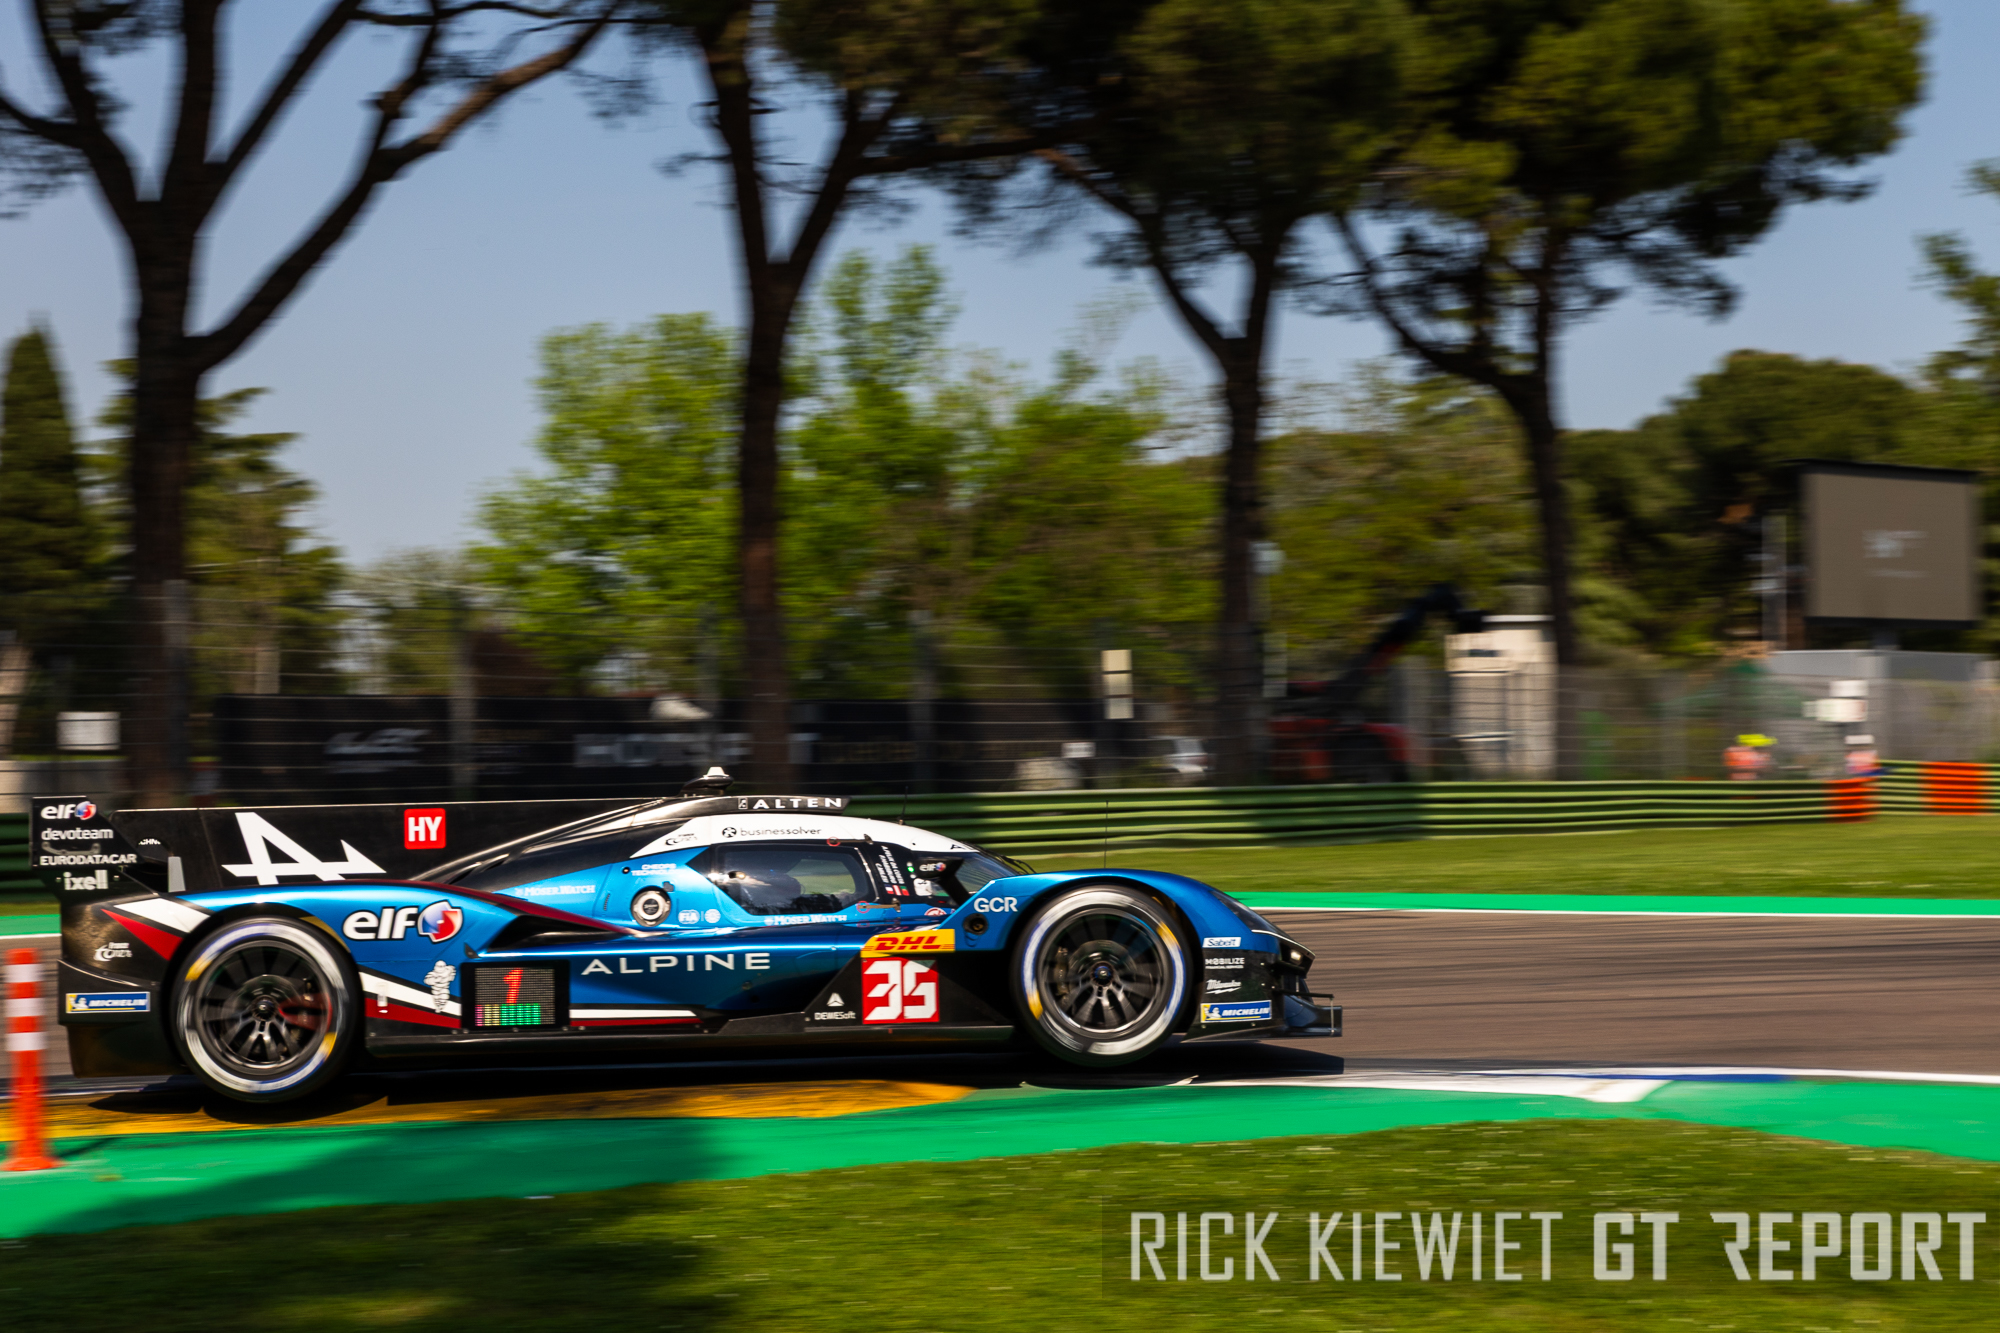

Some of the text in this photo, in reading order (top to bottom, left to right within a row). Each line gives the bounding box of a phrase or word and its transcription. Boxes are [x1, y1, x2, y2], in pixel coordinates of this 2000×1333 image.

[753, 798, 842, 809] ALTEN
[41, 804, 76, 820] elf
[41, 827, 114, 840] devoteam
[408, 816, 443, 842] HY
[740, 826, 822, 836] businessolver
[138, 838, 161, 846] CHN
[40, 853, 137, 866] EURODATACAR
[919, 863, 936, 872] elf
[63, 870, 108, 890] ixell
[973, 896, 1018, 913] GCR
[343, 907, 419, 940] elf
[875, 936, 941, 950] DHL
[1207, 939, 1236, 947] Sabelt
[581, 952, 770, 975] ALPINE
[503, 968, 523, 1004] 1
[864, 960, 937, 1021] 35
[88, 999, 148, 1007] MICHELIN
[1222, 1007, 1270, 1016] MICHELIN
